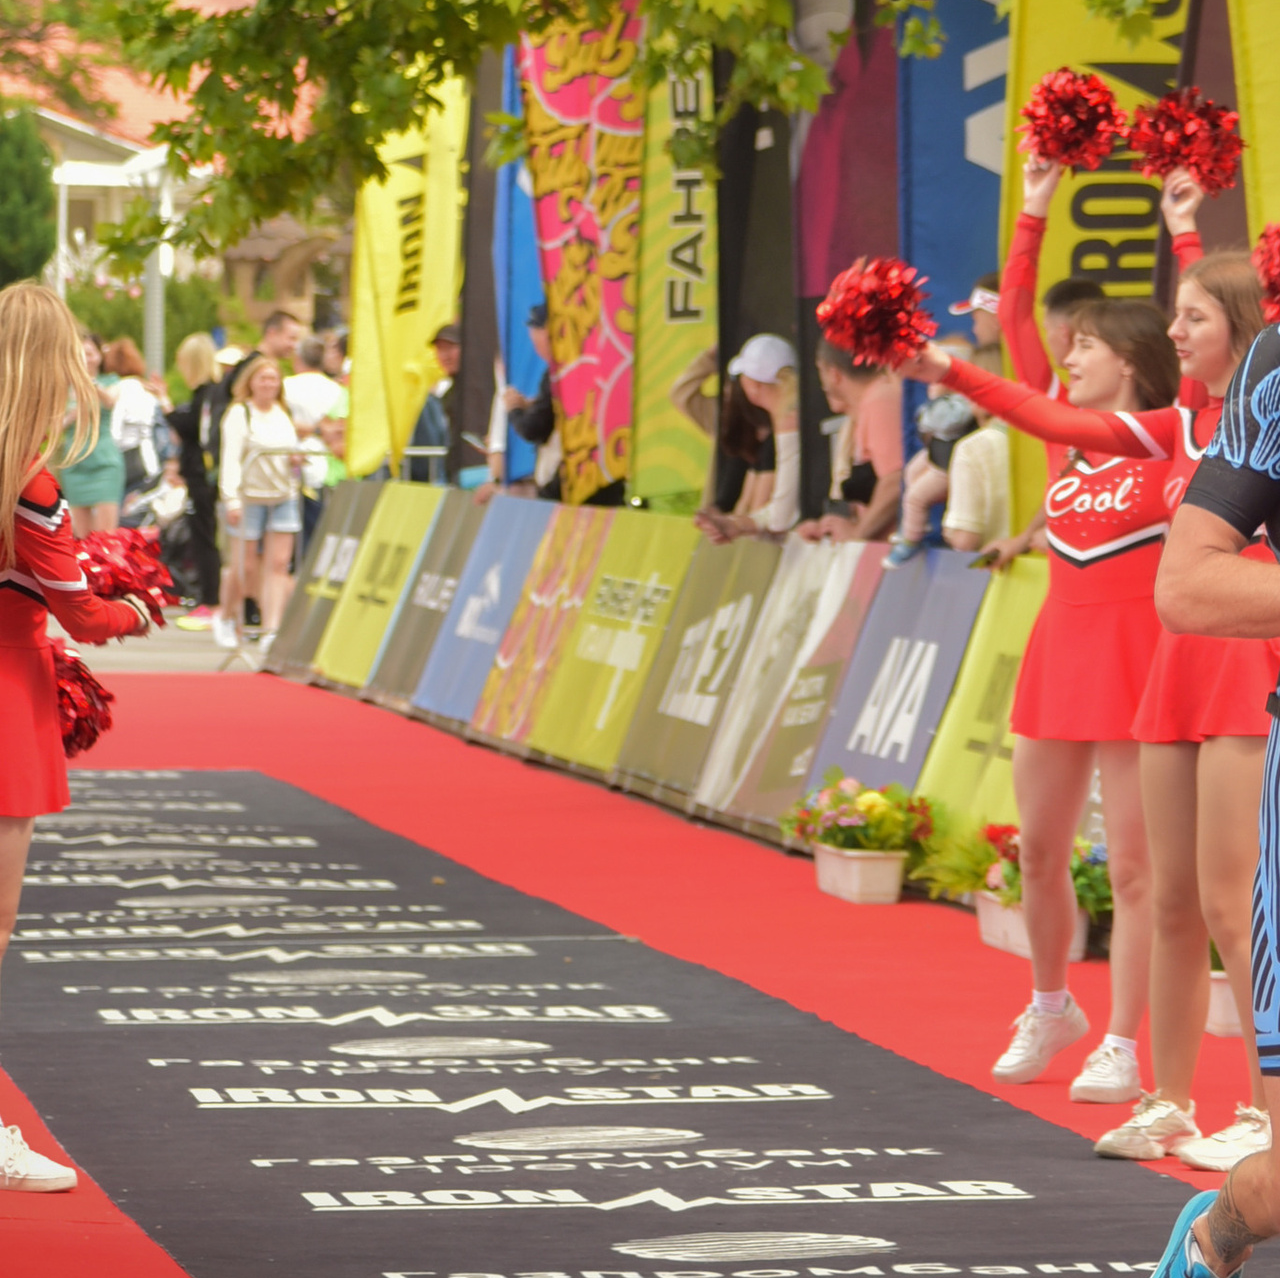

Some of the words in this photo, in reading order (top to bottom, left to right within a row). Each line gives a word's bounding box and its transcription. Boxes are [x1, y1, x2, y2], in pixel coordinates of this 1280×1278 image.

[1045, 476, 1134, 518] Cool
[846, 636, 938, 763] AVA
[321, 943, 536, 955] STAR
[97, 1005, 322, 1020] IRON
[430, 1004, 670, 1018] STAR
[188, 1087, 443, 1103] IRON
[563, 1083, 829, 1100] STAR
[251, 1147, 944, 1168] Газпромбанк
[300, 1189, 589, 1207] IRON
[726, 1180, 1032, 1200] STAR
